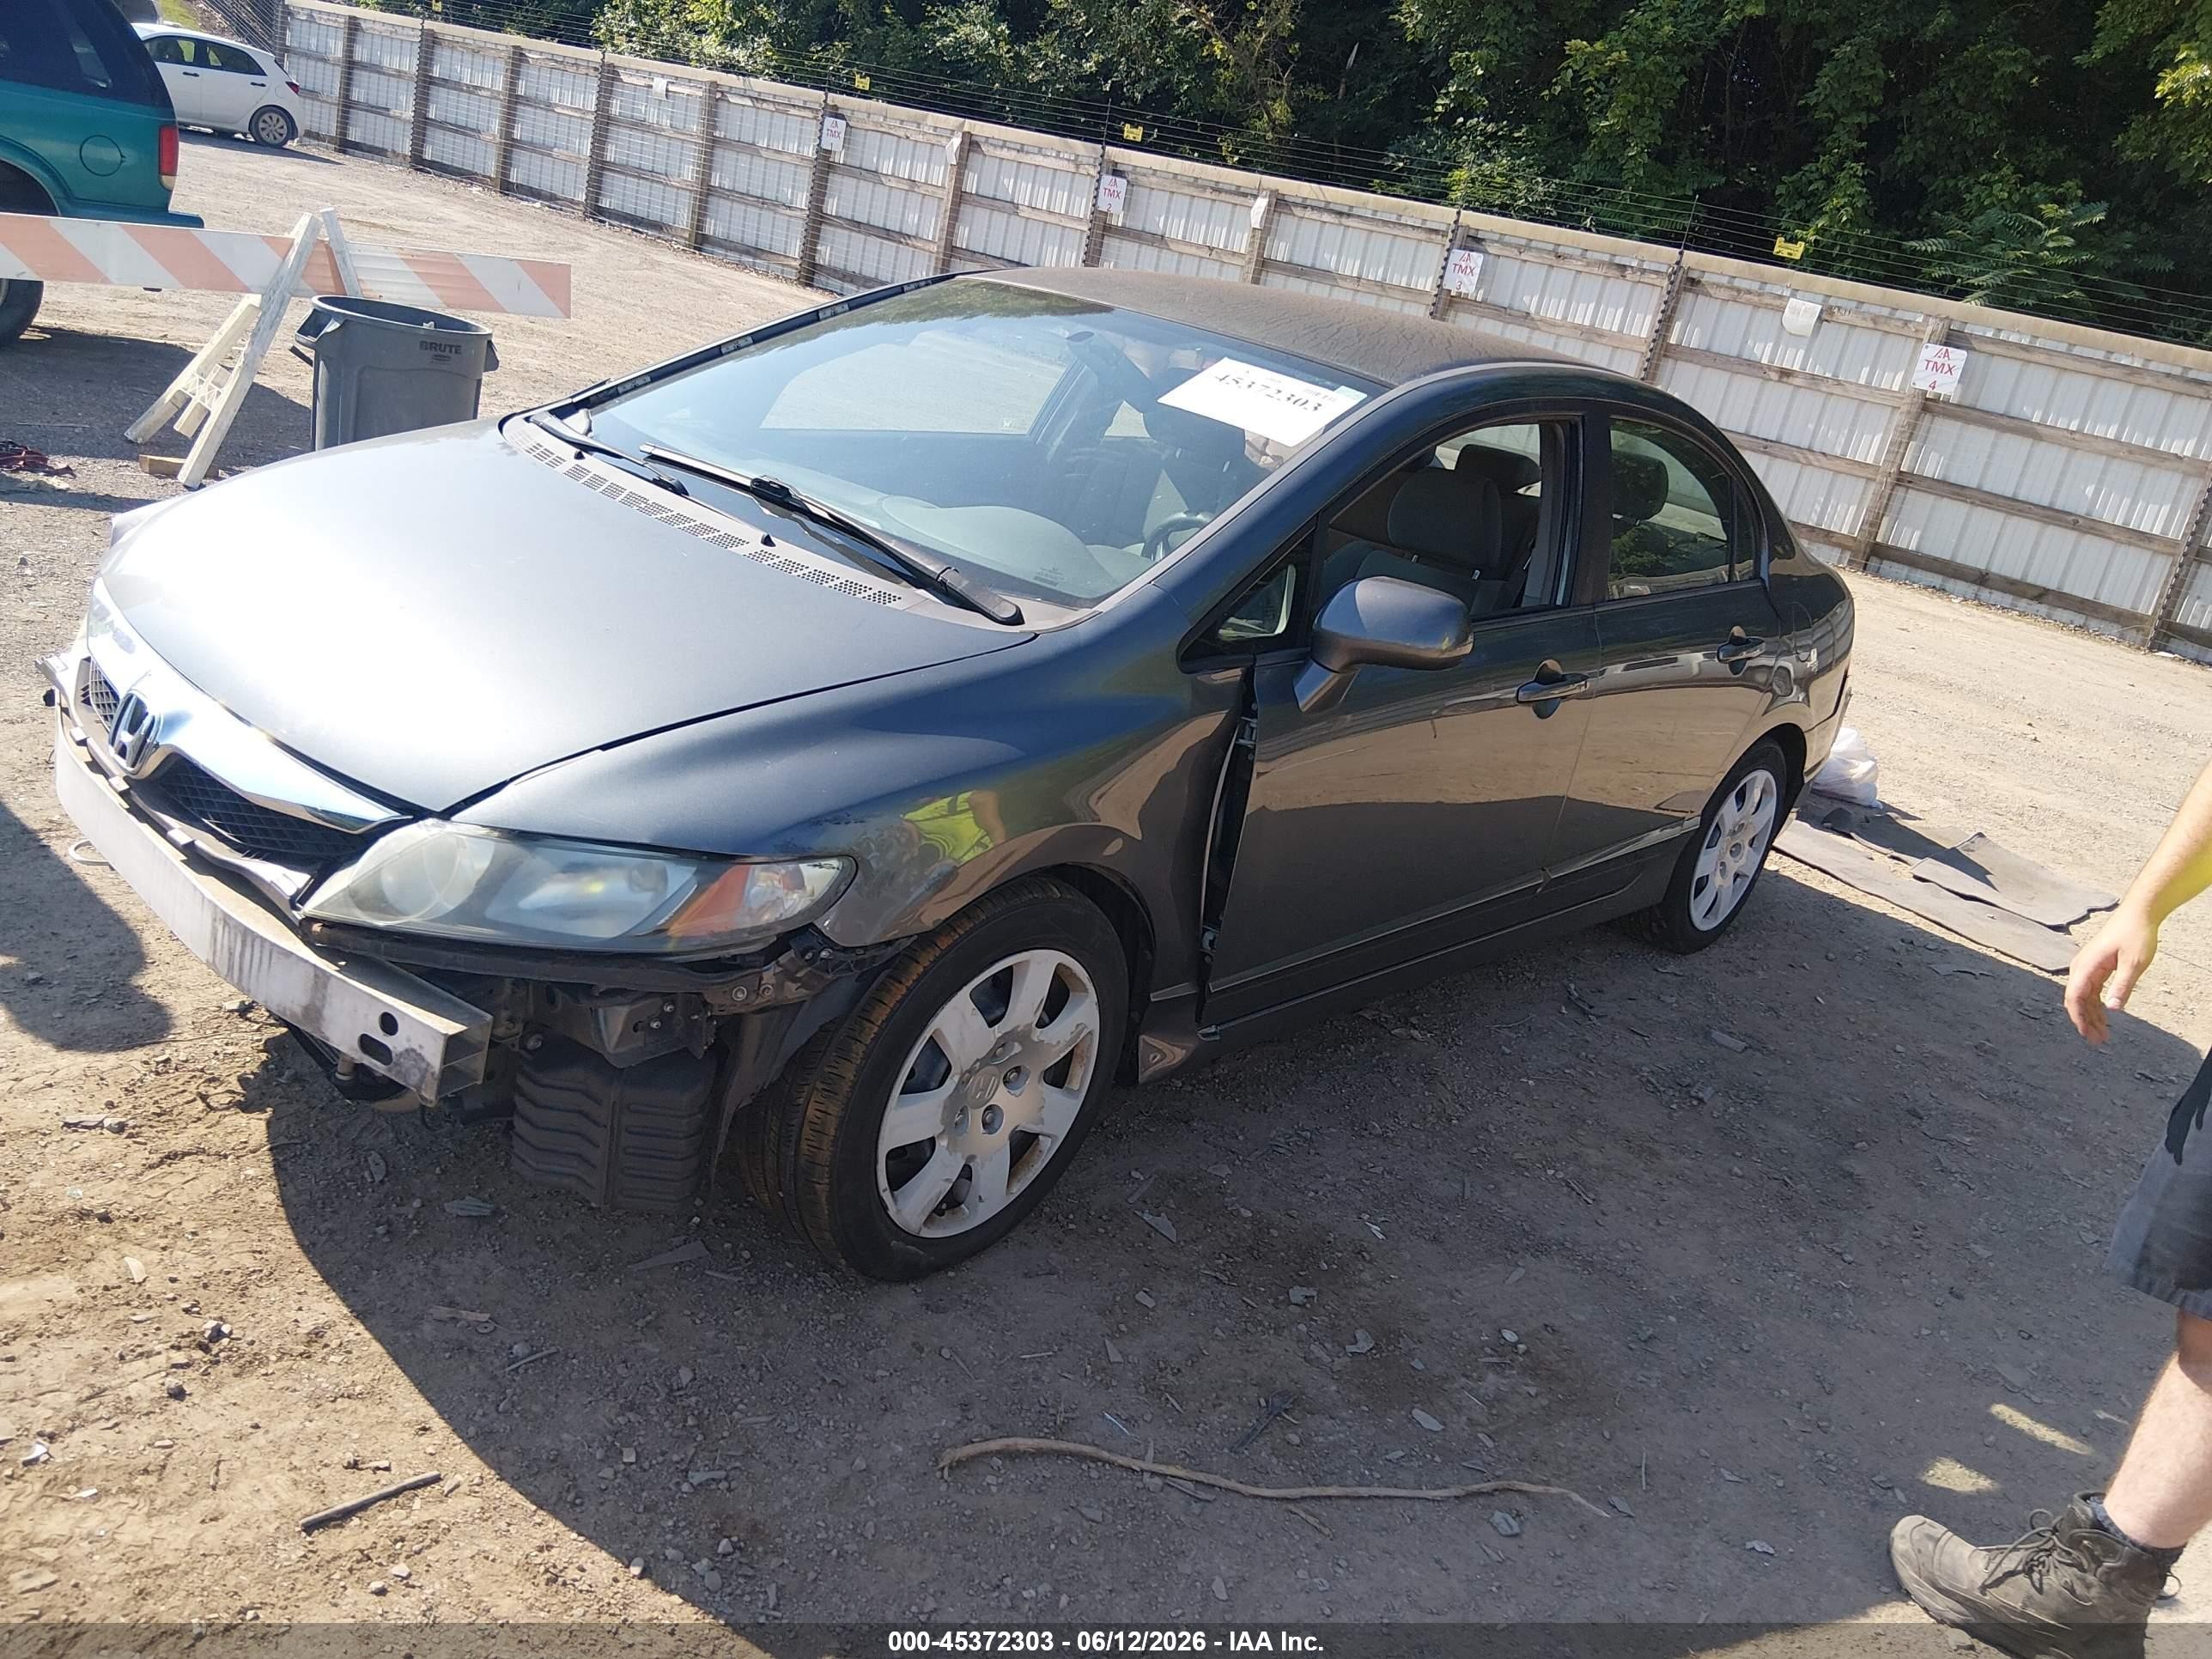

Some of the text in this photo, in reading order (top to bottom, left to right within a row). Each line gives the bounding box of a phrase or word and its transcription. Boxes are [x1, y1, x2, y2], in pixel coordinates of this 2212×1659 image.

[1103, 187, 1121, 200] TMX
[1106, 204, 1113, 212] 2
[1452, 263, 1476, 276] TMX
[1455, 281, 1463, 290] 3
[419, 340, 462, 355] BRUTE
[1924, 359, 1956, 376] TMX
[1929, 380, 1937, 390] 4
